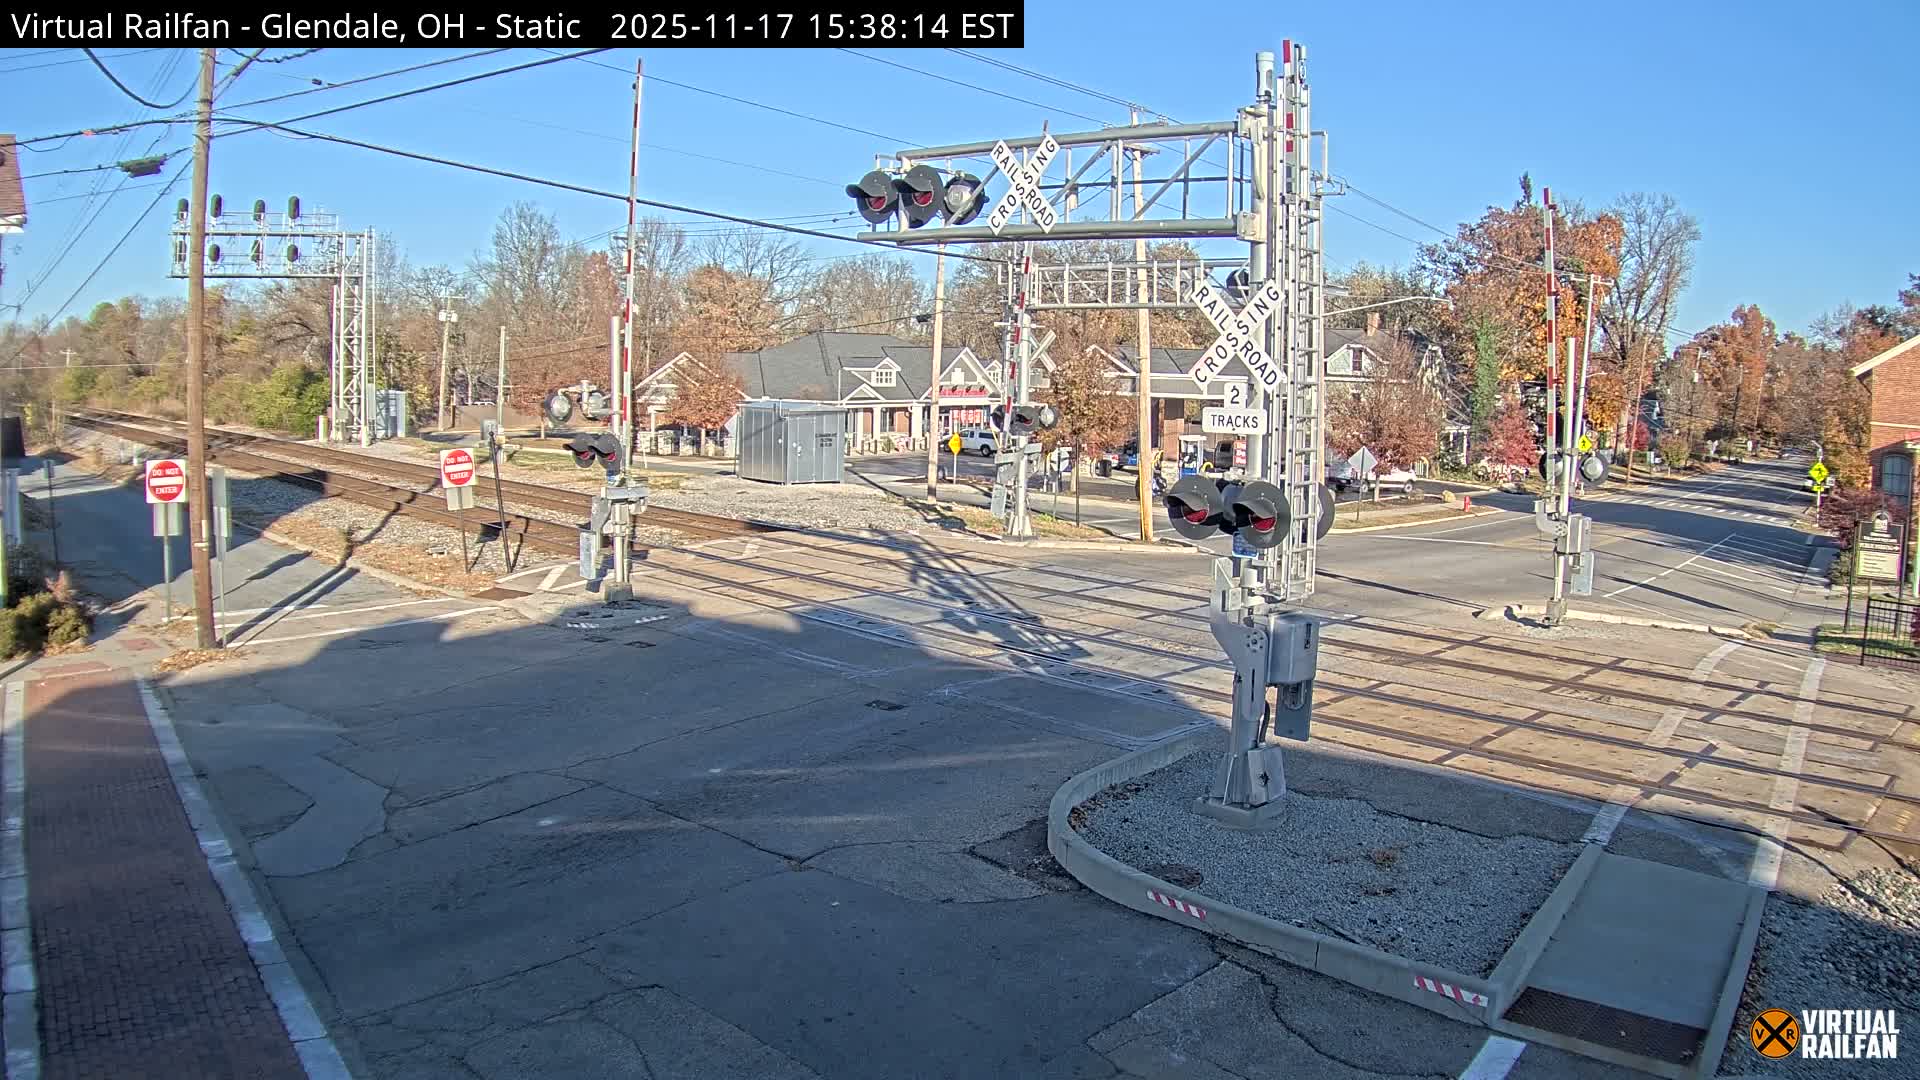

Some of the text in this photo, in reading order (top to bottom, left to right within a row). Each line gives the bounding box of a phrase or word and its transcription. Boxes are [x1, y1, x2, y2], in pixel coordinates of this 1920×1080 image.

[991, 140, 1055, 228] CROSSING
[1194, 286, 1279, 383] CROSSING
[1230, 387, 1240, 404] 2
[1211, 414, 1258, 429] TRACKS
[152, 467, 179, 477] DO NOT
[450, 472, 469, 480] ENTER
[156, 486, 177, 495] ENTER
